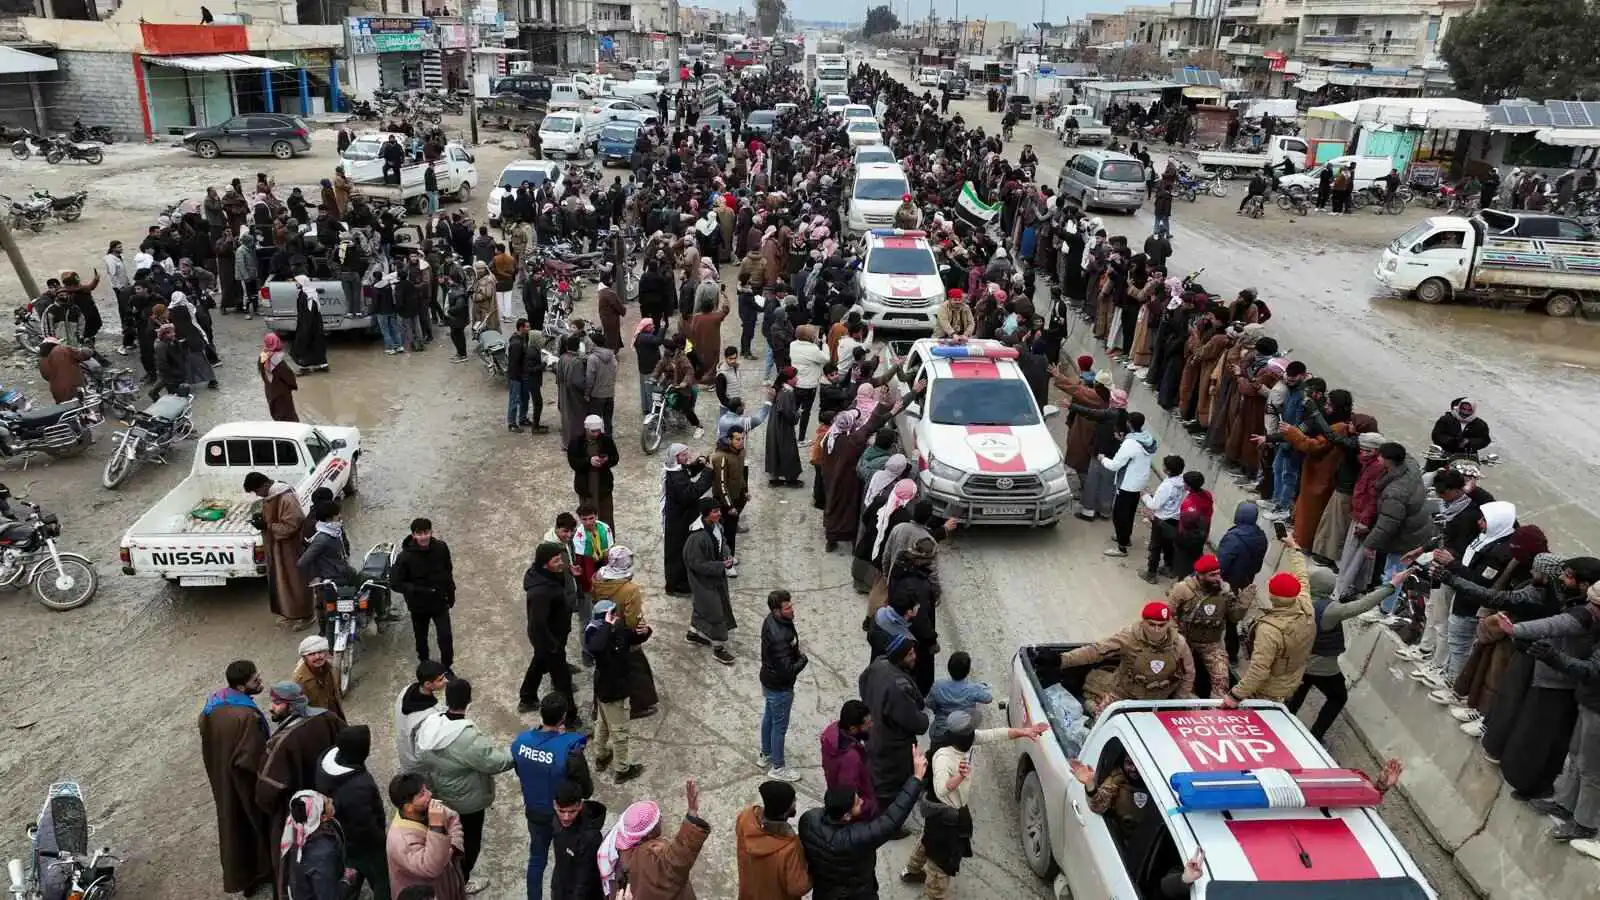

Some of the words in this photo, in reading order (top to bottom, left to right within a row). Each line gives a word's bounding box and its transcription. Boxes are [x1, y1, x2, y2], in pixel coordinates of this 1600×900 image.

[151, 551, 235, 566] NISSAN
[1170, 715, 1250, 726] MILITARY
[1178, 724, 1265, 738] POLICE
[518, 743, 554, 765] PRESS
[1187, 738, 1276, 765] MP
